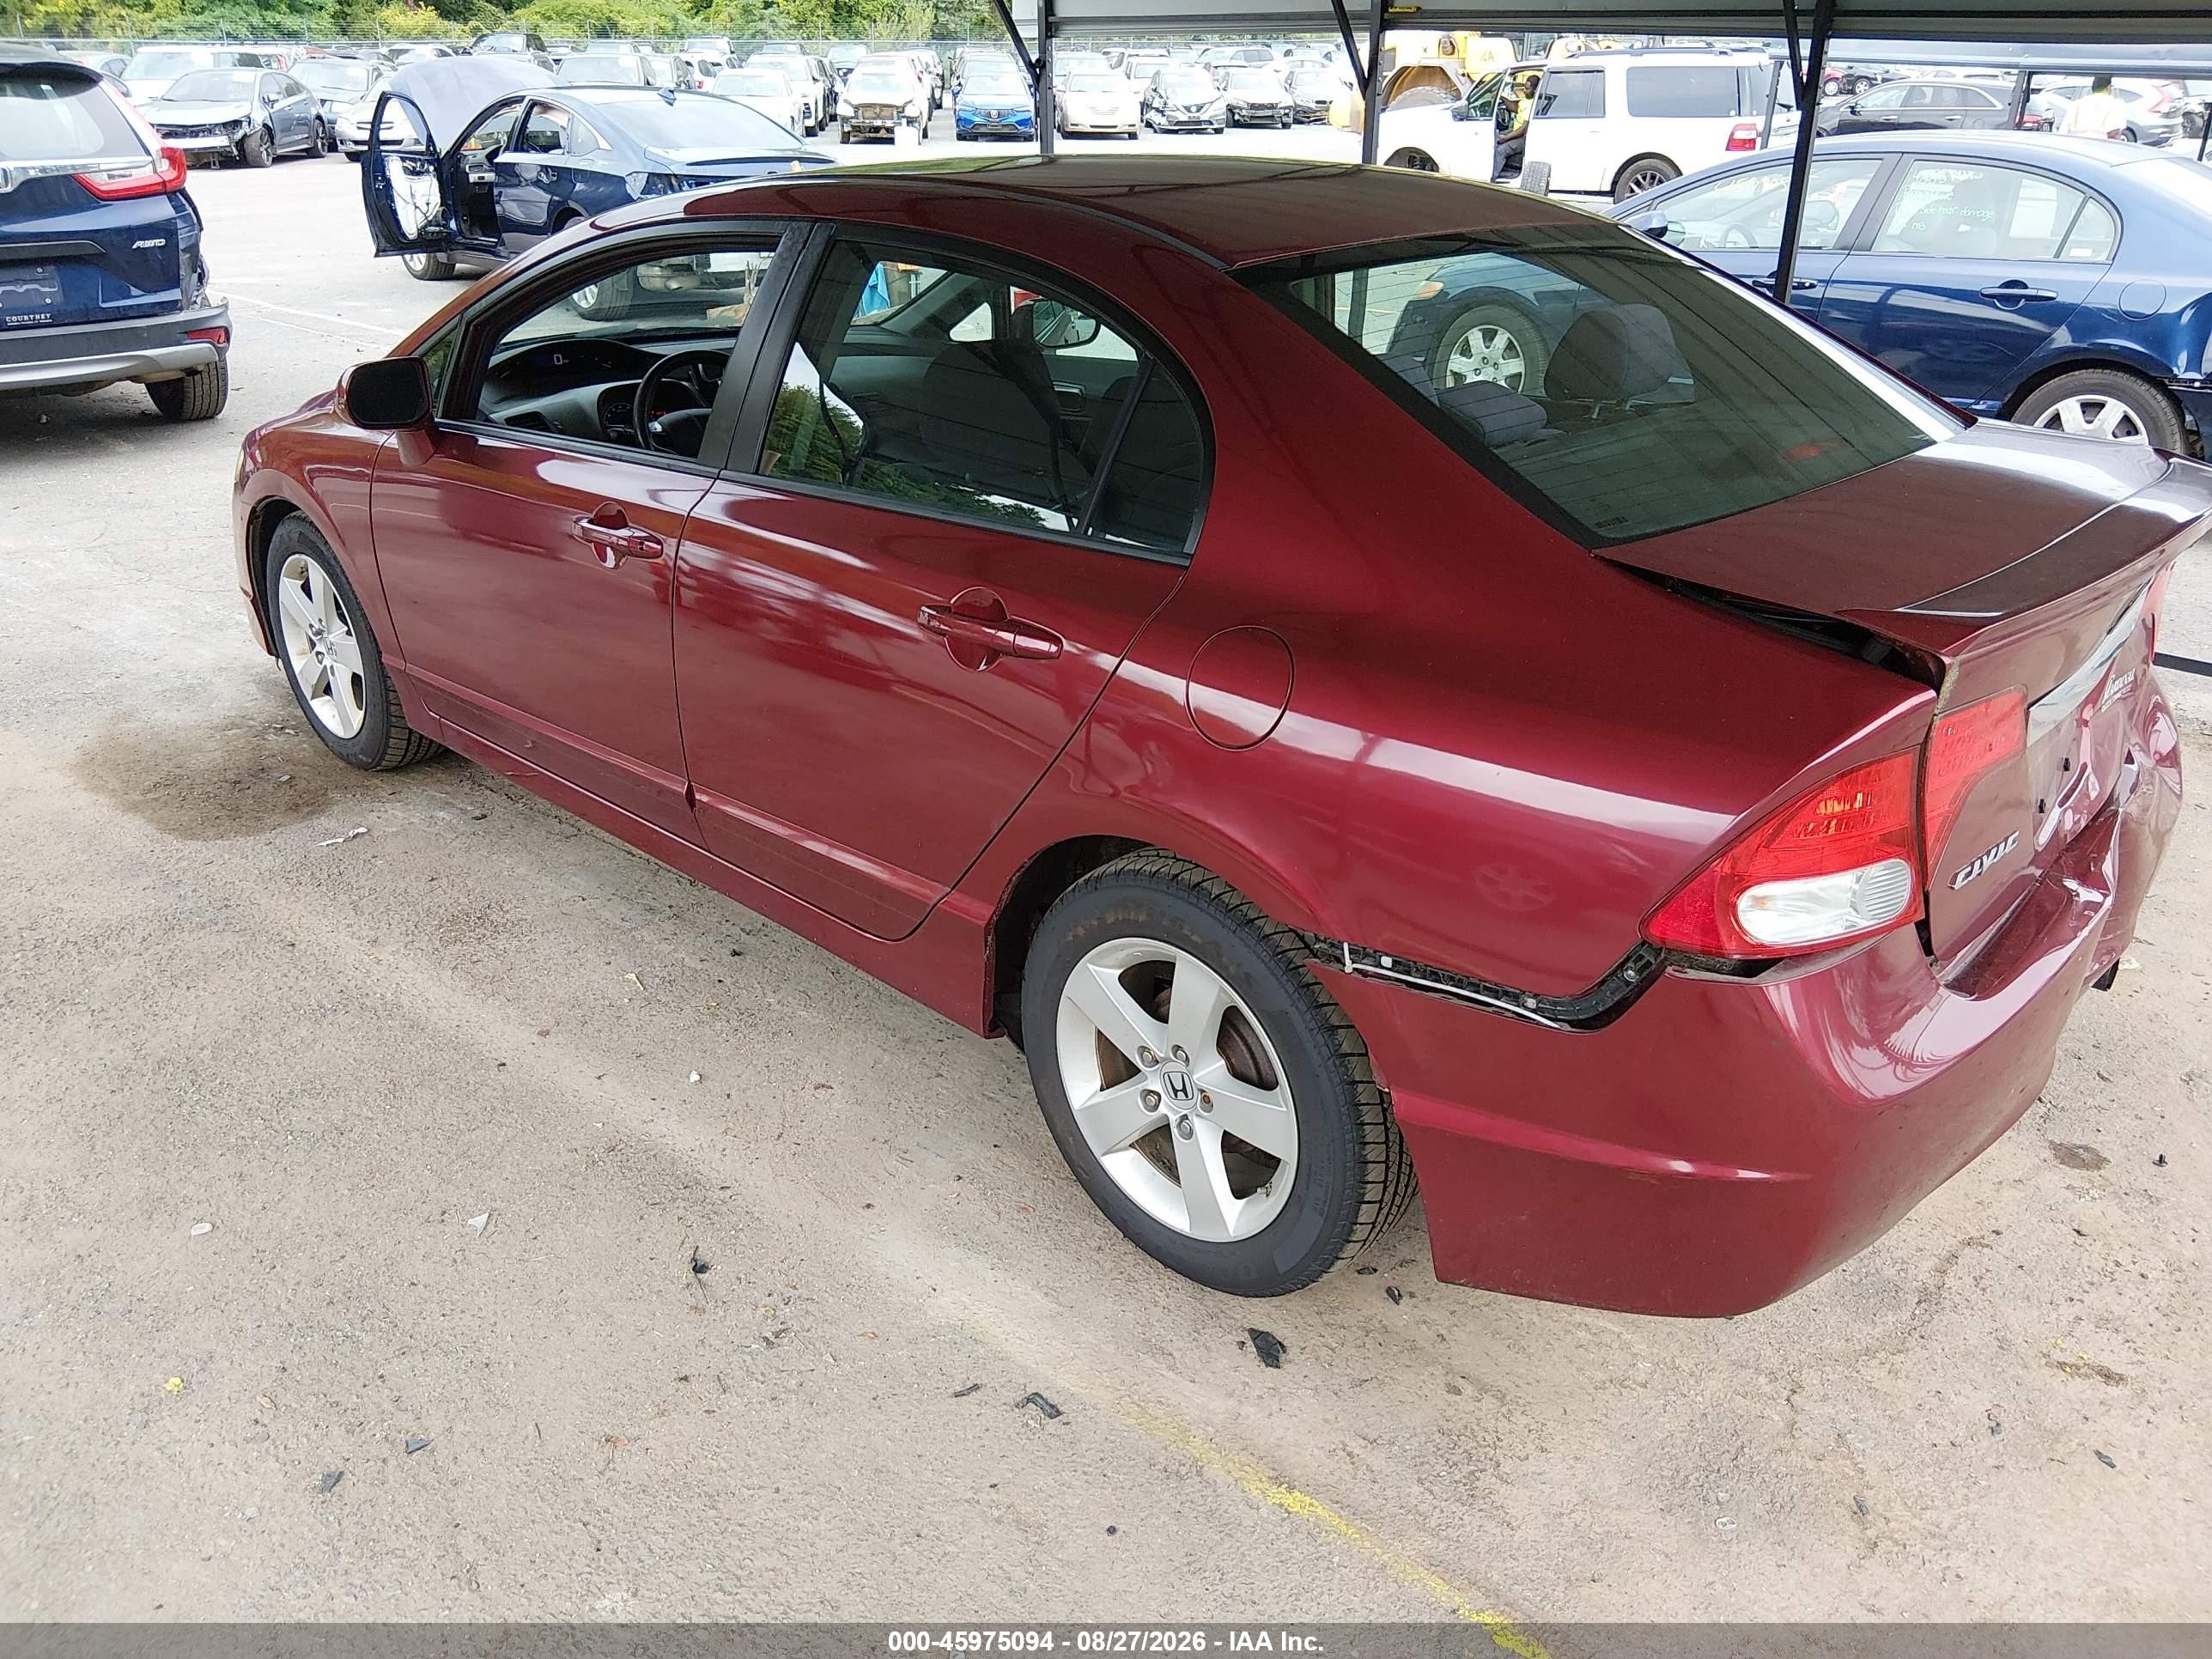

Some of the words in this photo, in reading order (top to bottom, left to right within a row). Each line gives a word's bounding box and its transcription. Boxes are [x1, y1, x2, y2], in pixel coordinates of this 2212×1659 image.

[131, 239, 167, 249] AWD
[6, 313, 52, 323] COURTNEY
[1947, 830, 2020, 890] CIVIC
